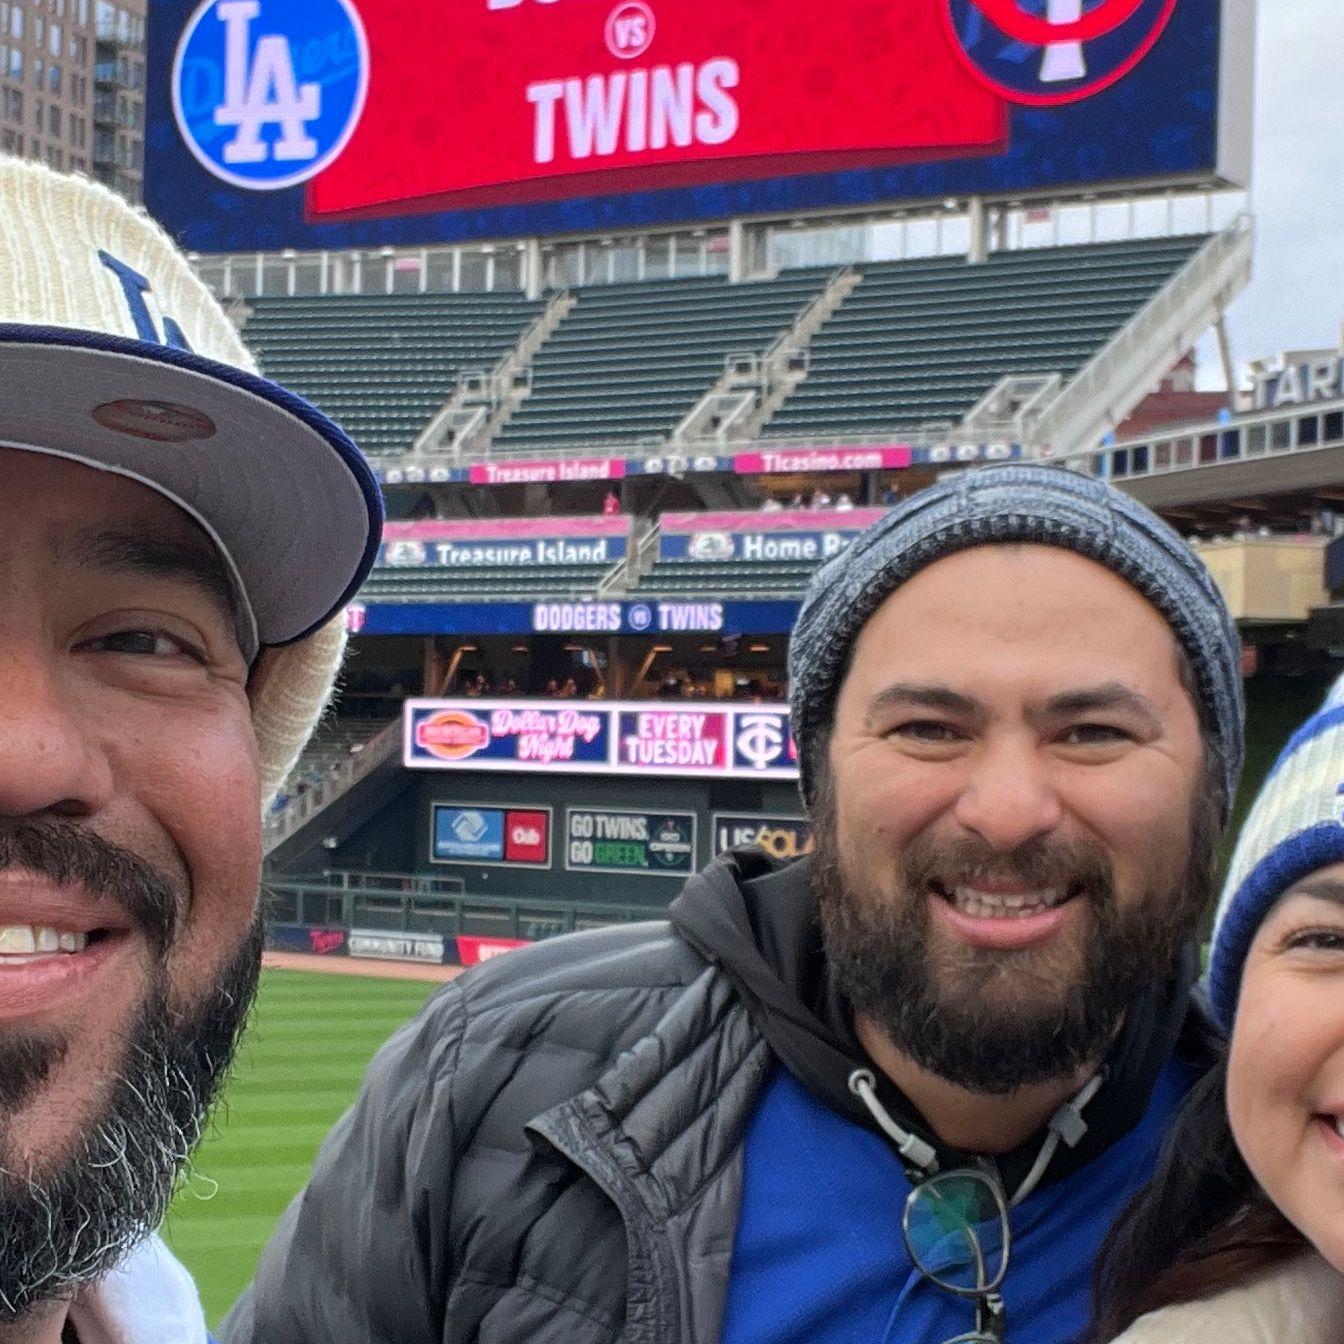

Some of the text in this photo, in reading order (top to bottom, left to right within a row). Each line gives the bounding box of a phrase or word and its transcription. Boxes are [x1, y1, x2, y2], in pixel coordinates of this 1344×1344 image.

[613, 16, 648, 49] VS
[527, 58, 740, 164] TWINS
[487, 461, 610, 484] Treasure Island
[436, 541, 607, 566] Treasure Island
[745, 535, 818, 560] Home
[533, 604, 621, 631] DODGERS
[659, 603, 724, 630] TWINS
[492, 709, 558, 736] Dollar
[558, 711, 601, 742] Dog
[638, 713, 706, 736] EVERY
[519, 734, 574, 763] Night
[625, 735, 720, 766] TUESDAY
[571, 814, 592, 838] GO
[571, 841, 592, 865] GO
